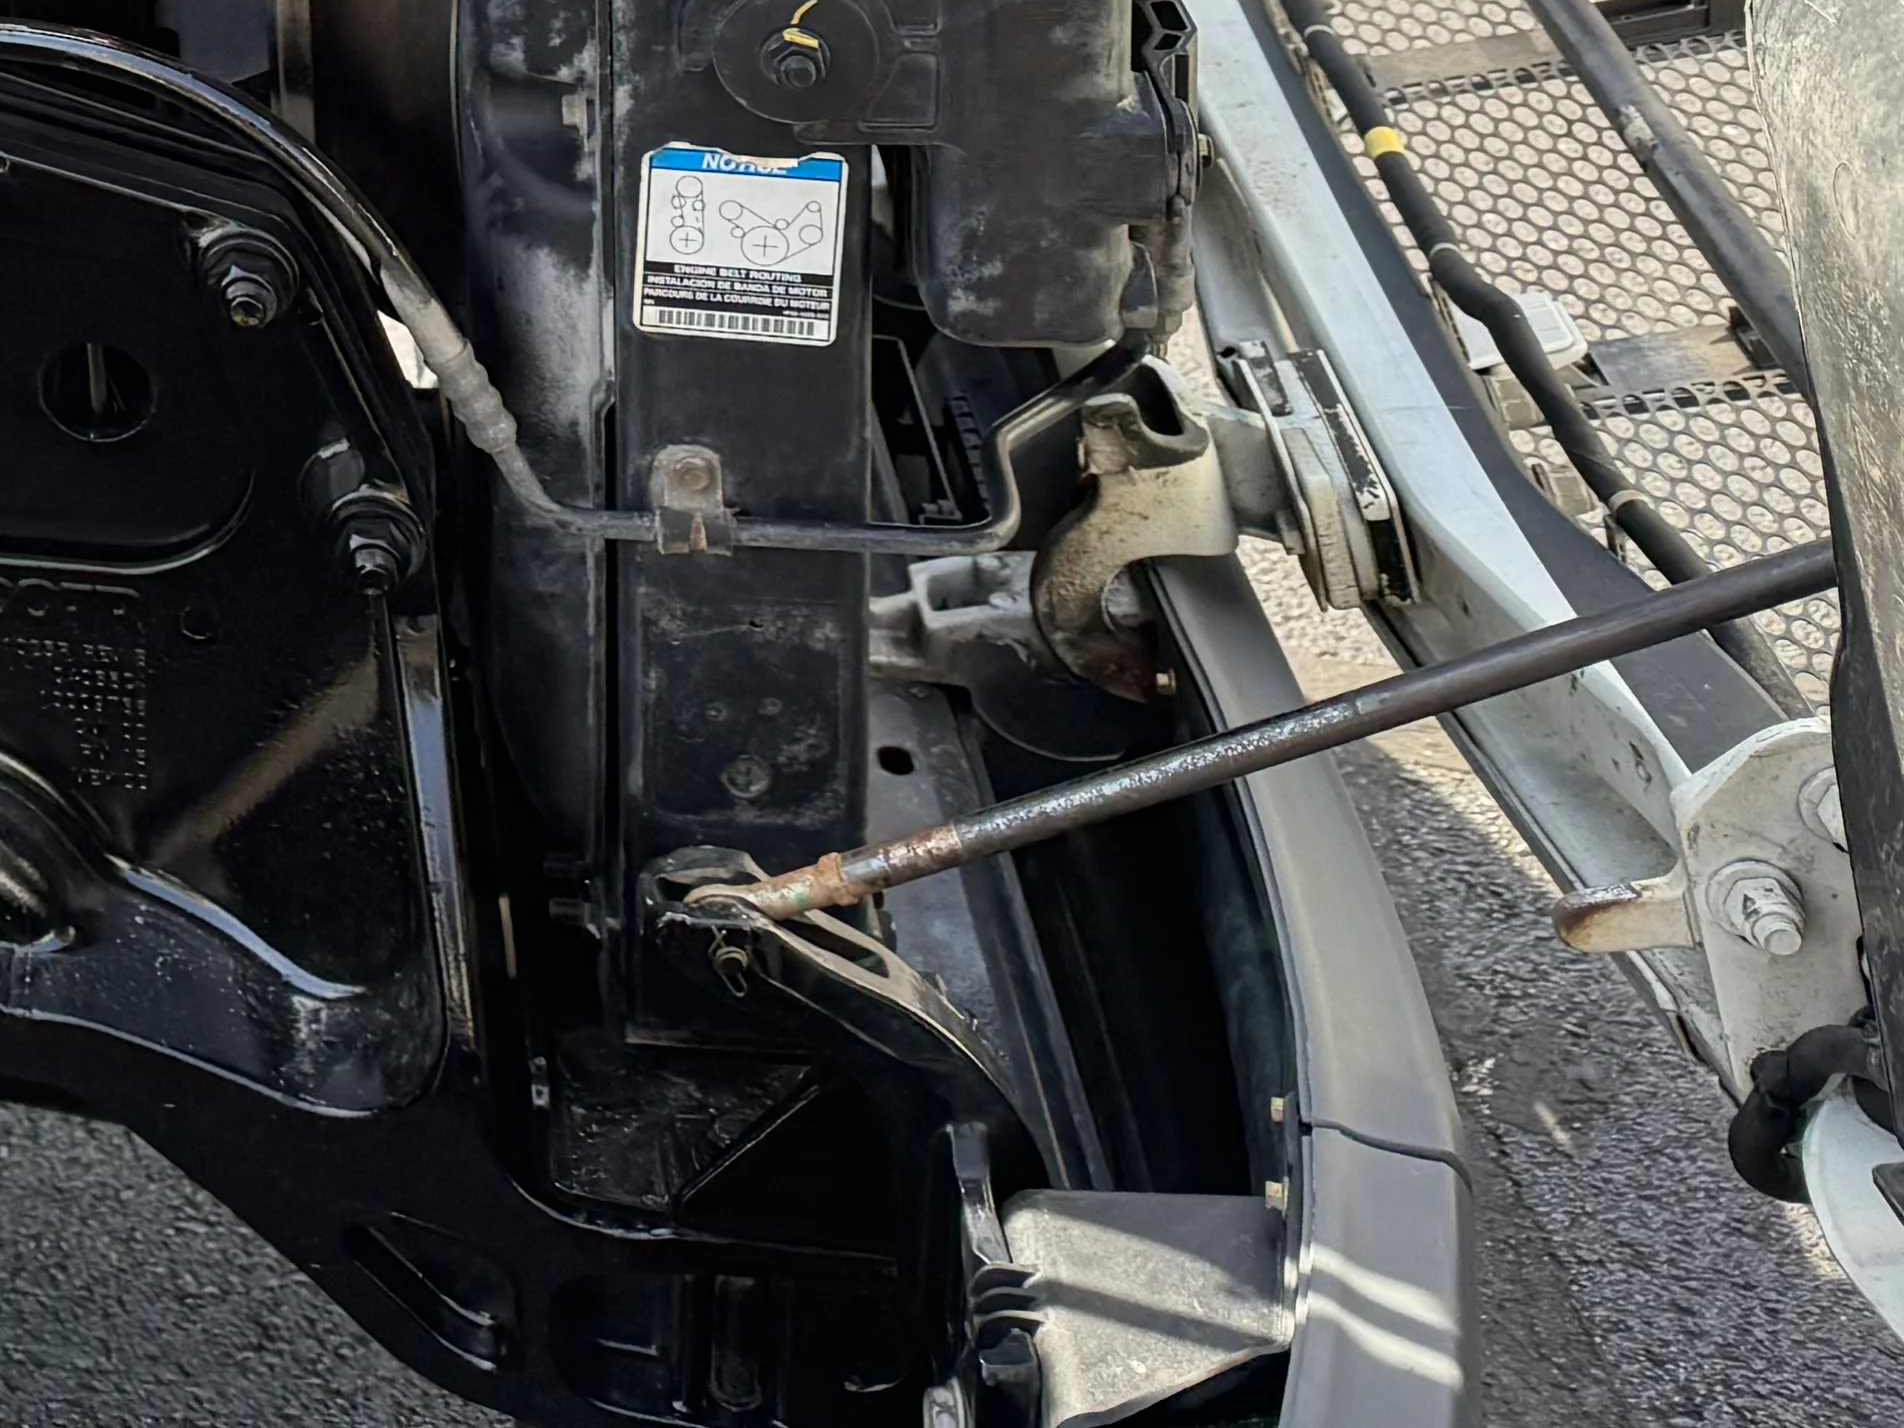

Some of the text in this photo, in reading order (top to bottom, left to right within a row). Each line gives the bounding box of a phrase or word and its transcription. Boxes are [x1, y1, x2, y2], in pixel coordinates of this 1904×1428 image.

[674, 264, 803, 283] ENGINE BELT ROUTING
[717, 281, 731, 291] DE
[772, 286, 787, 295] DE
[788, 287, 828, 298] MOTOR
[643, 287, 693, 300] PARCOURS
[695, 292, 708, 301] DE
[709, 293, 723, 303] LA
[774, 298, 789, 308] DU
[789, 299, 830, 312] MOTEUR
